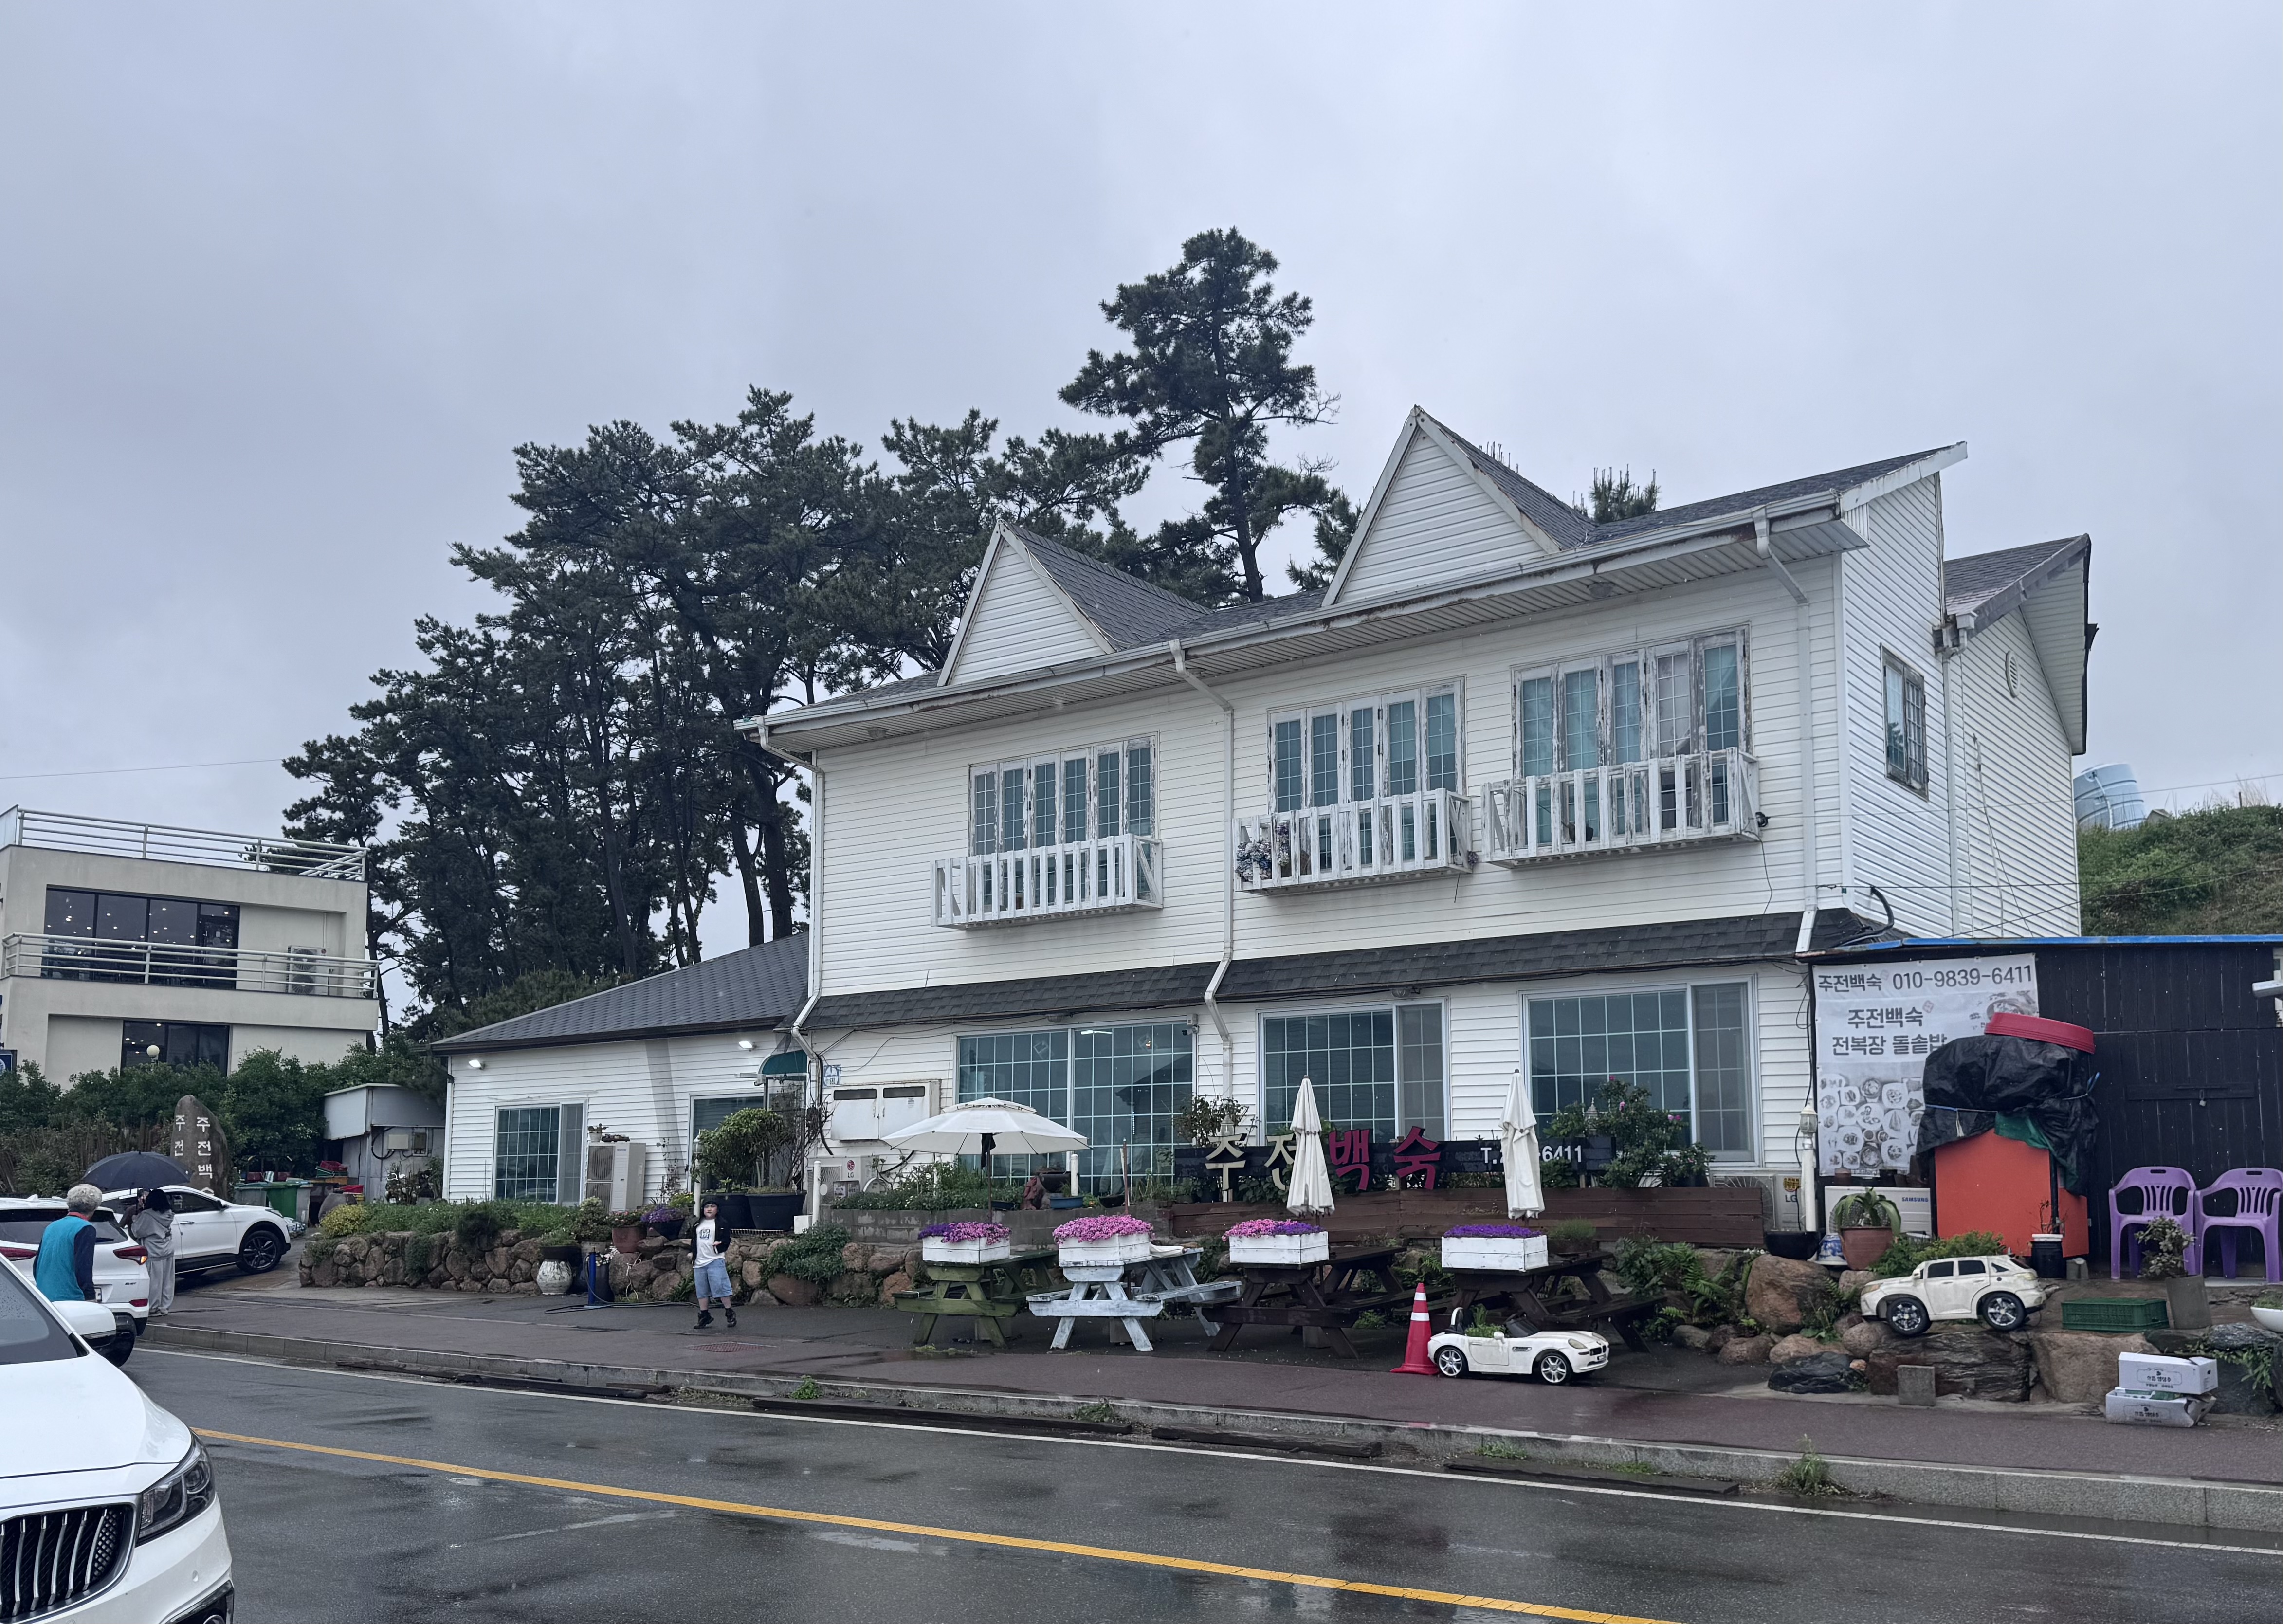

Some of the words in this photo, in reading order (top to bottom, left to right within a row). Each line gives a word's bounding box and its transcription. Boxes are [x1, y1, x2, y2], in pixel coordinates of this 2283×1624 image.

[1818, 974, 1882, 992] 주전백숙
[1893, 965, 2032, 990] 010-9839-6411
[1848, 1007, 1923, 1029] 주전백숙
[1832, 1035, 1886, 1056] 전복장
[1892, 1034, 1948, 1055] 돌솥밥
